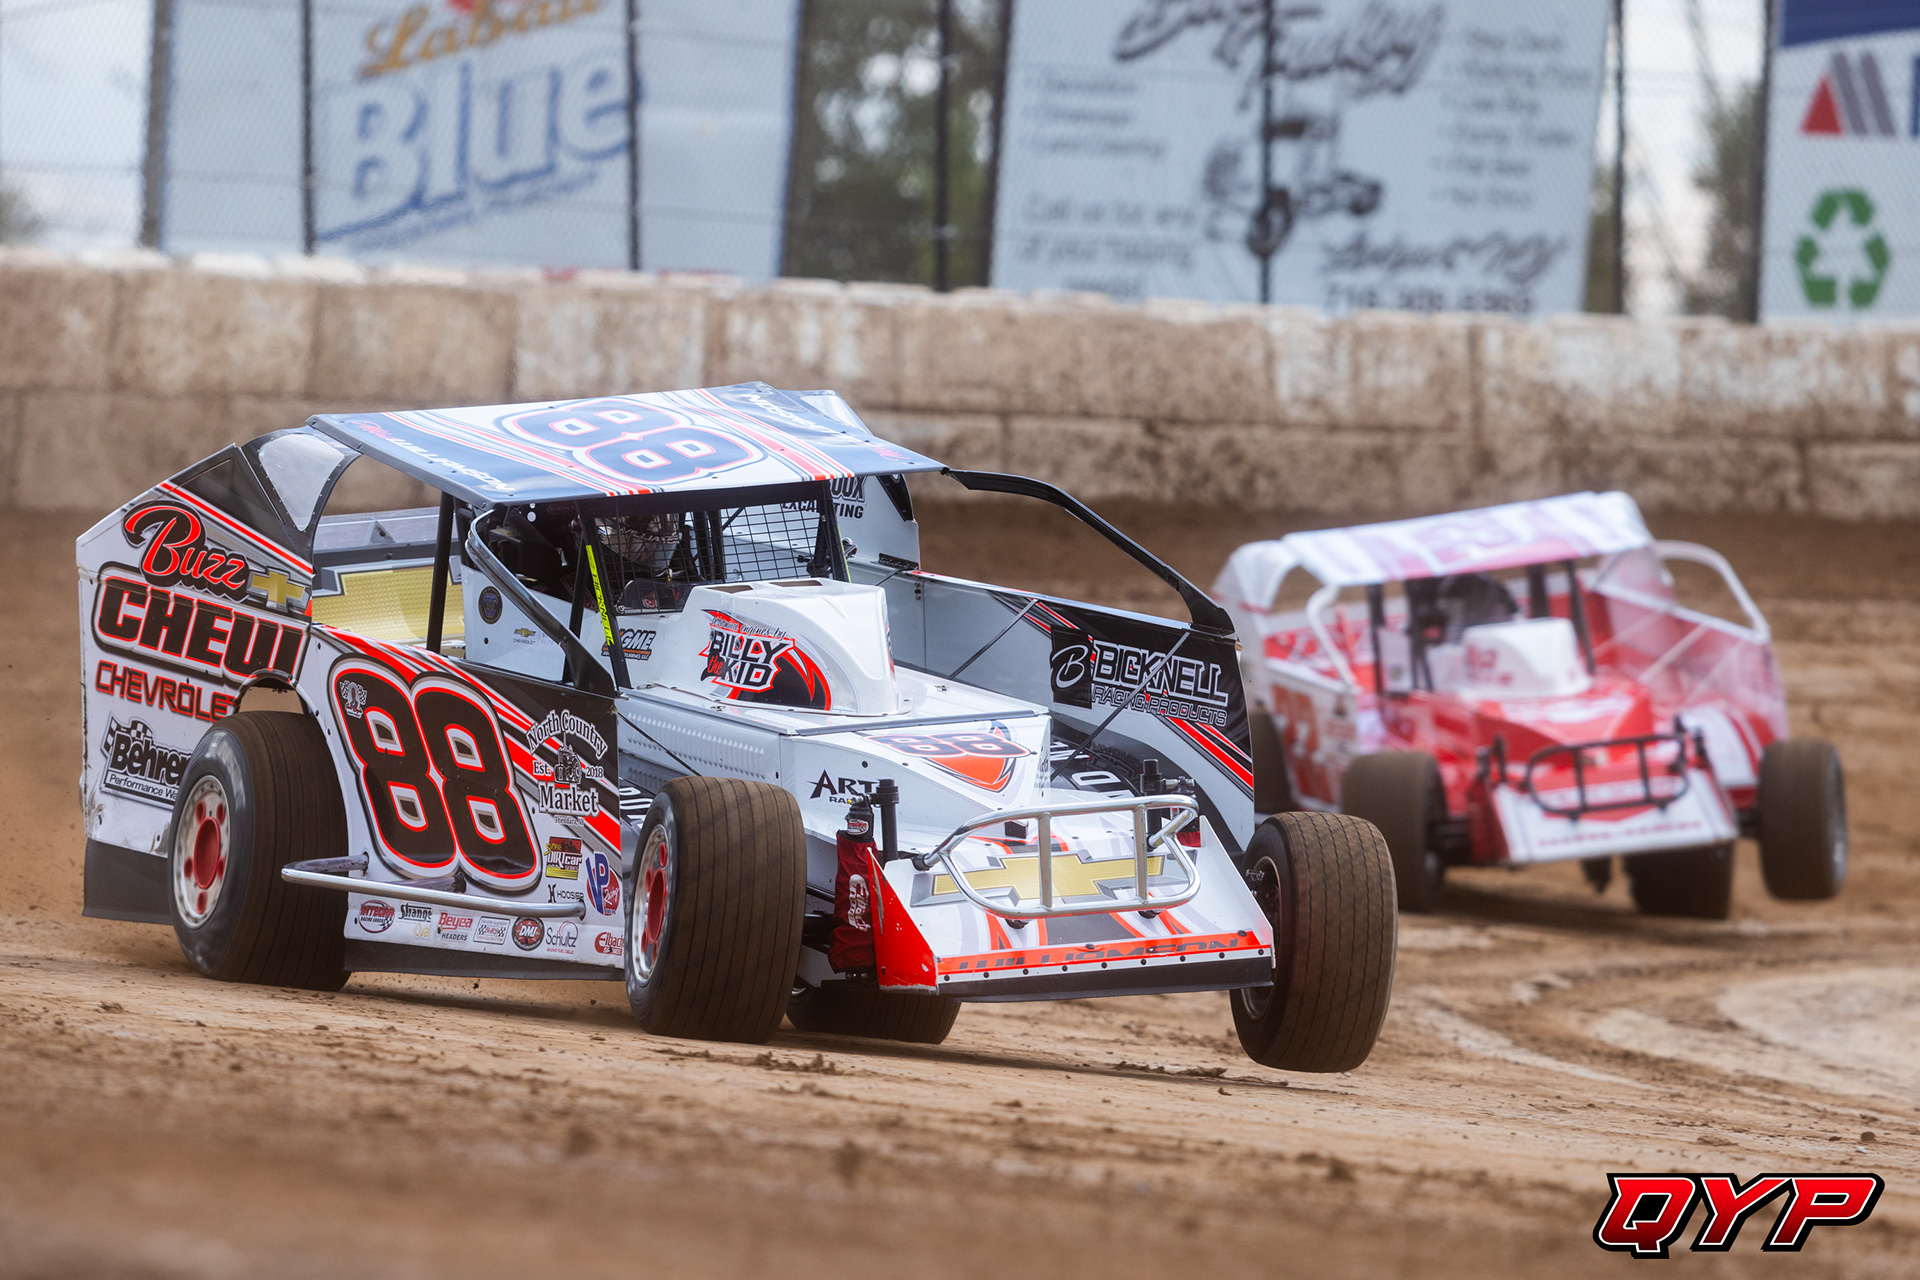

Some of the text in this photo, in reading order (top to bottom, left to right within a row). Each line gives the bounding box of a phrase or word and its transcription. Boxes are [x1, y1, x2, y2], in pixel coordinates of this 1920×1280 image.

[318, 46, 642, 205] Blue
[511, 399, 756, 483] 88
[122, 502, 250, 600] Buzz
[709, 630, 791, 664] BILLY
[708, 656, 773, 687] the KID
[1092, 639, 1229, 706] BICKNELL
[1092, 683, 1228, 727] RACING PRODUCTS
[527, 709, 608, 759] North Country
[109, 773, 164, 796] Performance
[334, 667, 537, 880] 88
[533, 761, 604, 778] Est. 2018
[540, 782, 600, 817] Market
[585, 853, 609, 914] VP
[399, 903, 432, 922] Strange
[438, 912, 473, 930] Beyea
[442, 933, 467, 941] HEADERS
[519, 925, 537, 938] DMI
[546, 926, 576, 947] Schultz
